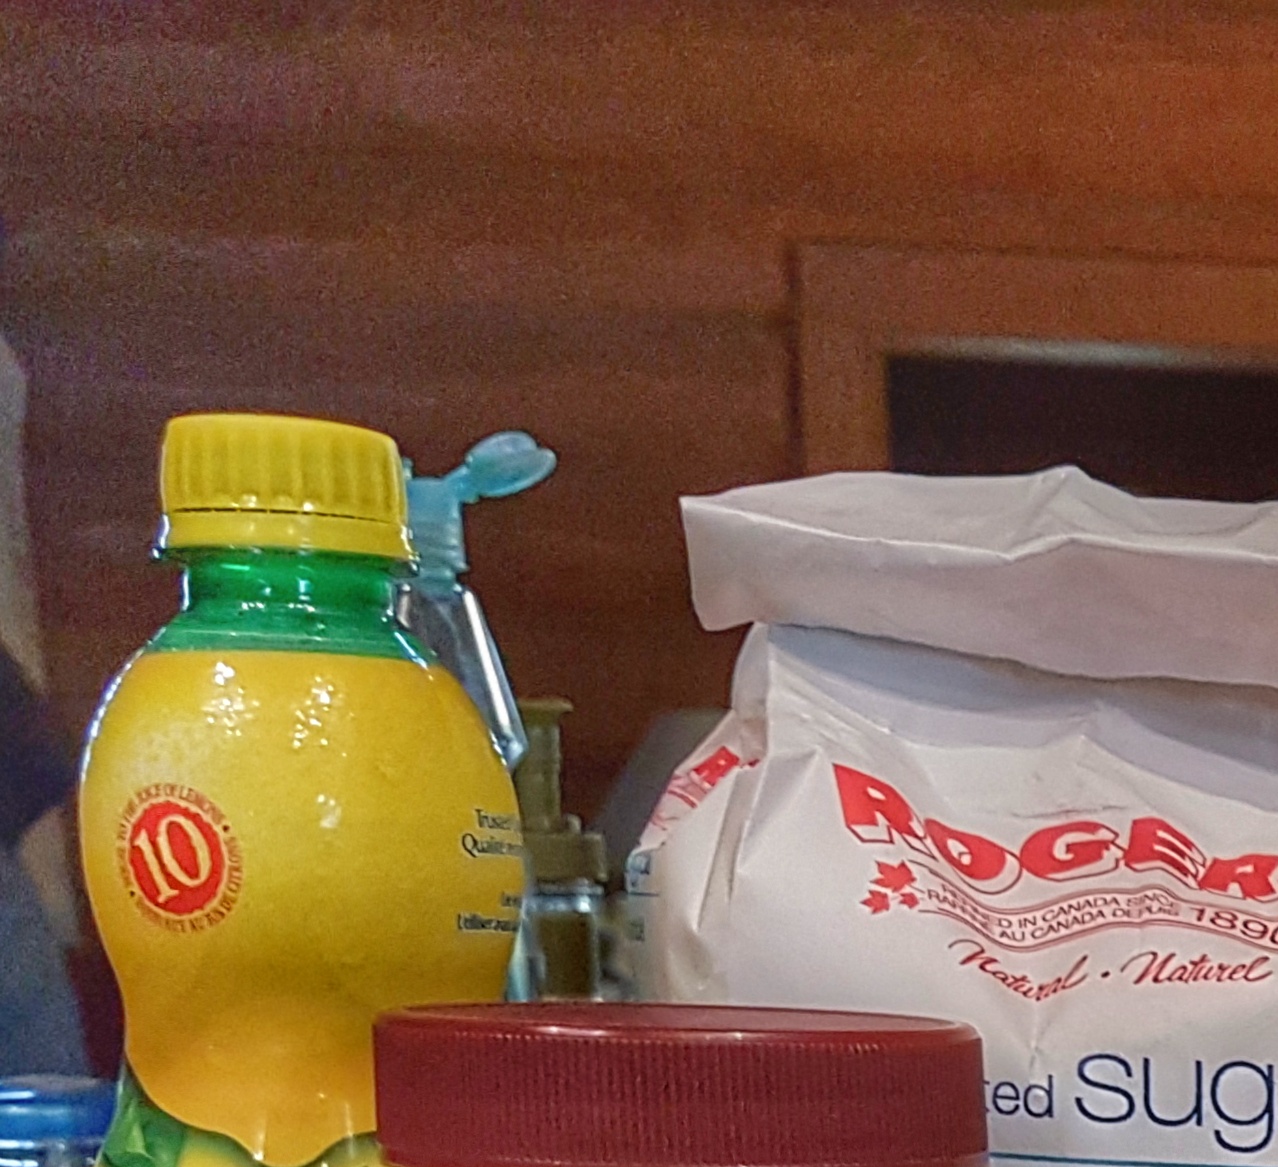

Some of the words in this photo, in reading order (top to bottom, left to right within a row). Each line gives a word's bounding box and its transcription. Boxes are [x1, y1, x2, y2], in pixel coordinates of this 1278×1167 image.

[132, 812, 212, 904] 10
[999, 929, 1026, 943] AU
[1030, 909, 1104, 939] CANADA
[1017, 914, 1037, 930] IN
[1041, 893, 1121, 924] CANADA
[948, 938, 1089, 1002] Natural
[1120, 951, 1274, 986] Naturel
